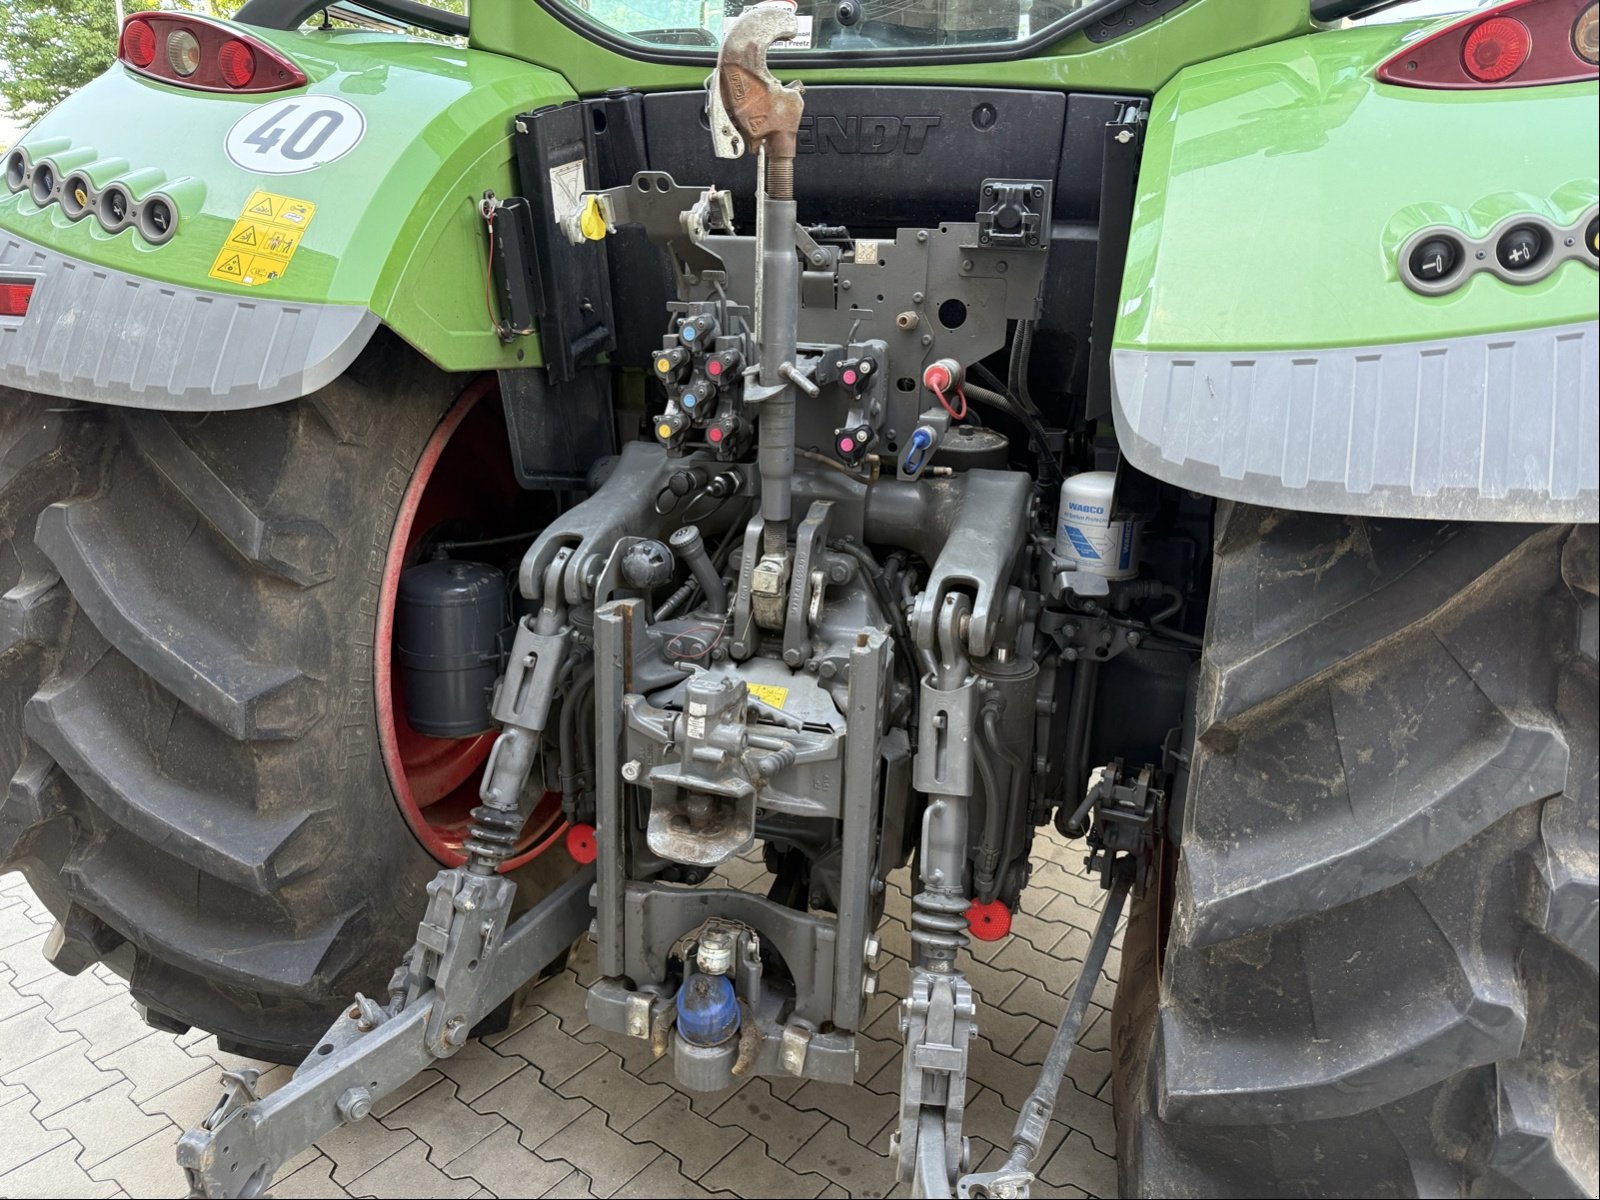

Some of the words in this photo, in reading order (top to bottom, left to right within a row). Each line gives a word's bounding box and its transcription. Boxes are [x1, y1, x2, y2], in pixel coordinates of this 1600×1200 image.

[243, 104, 344, 160] 40
[797, 115, 941, 155] ENDT
[1068, 502, 1104, 514] WABCO
